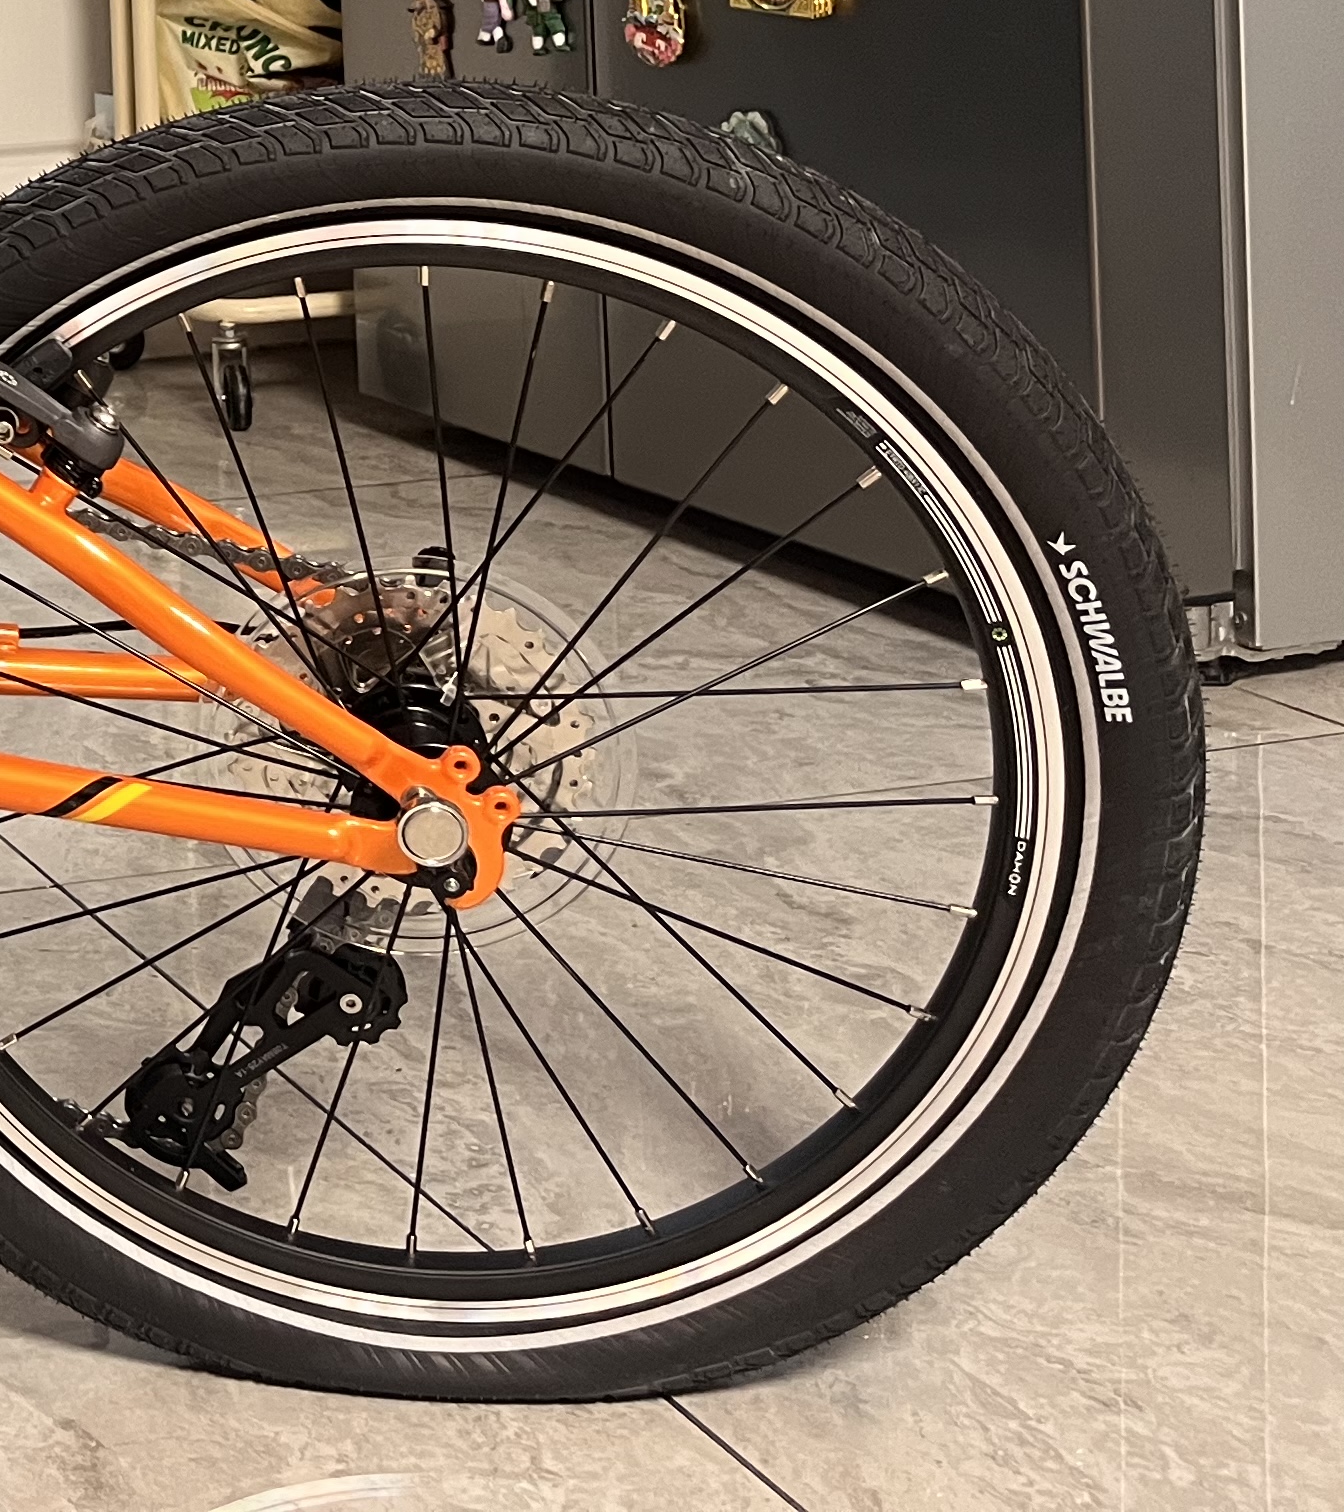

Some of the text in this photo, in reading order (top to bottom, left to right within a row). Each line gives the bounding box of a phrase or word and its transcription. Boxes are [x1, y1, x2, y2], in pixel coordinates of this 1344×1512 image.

[181, 29, 241, 55] MIXED
[1058, 560, 1133, 723] SCHWALBE
[1007, 840, 1027, 896] DAHON
